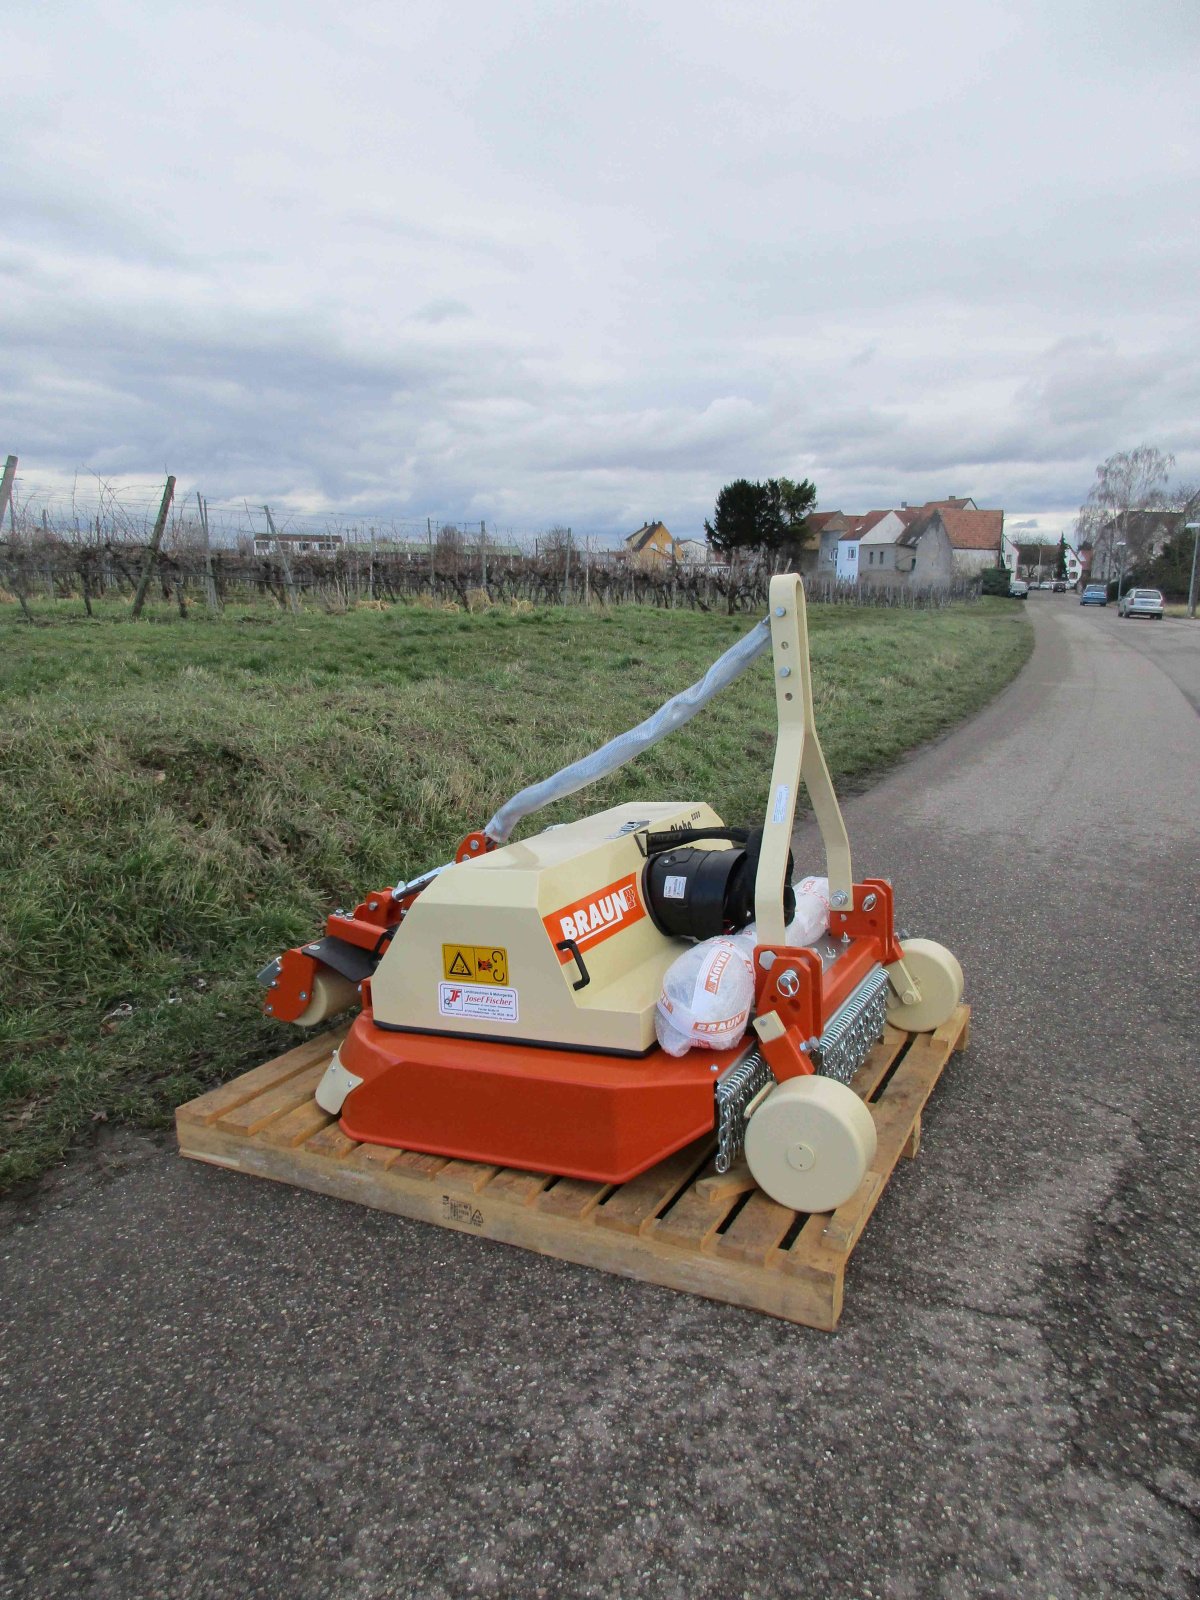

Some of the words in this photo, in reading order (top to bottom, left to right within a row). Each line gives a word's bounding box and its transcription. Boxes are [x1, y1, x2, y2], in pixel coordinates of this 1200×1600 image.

[560, 889, 629, 941] BRAUN
[709, 951, 730, 984] BRAUN
[465, 995, 485, 1003] Josef
[485, 996, 513, 1006] Fischer
[697, 1015, 741, 1032] BRAUN
